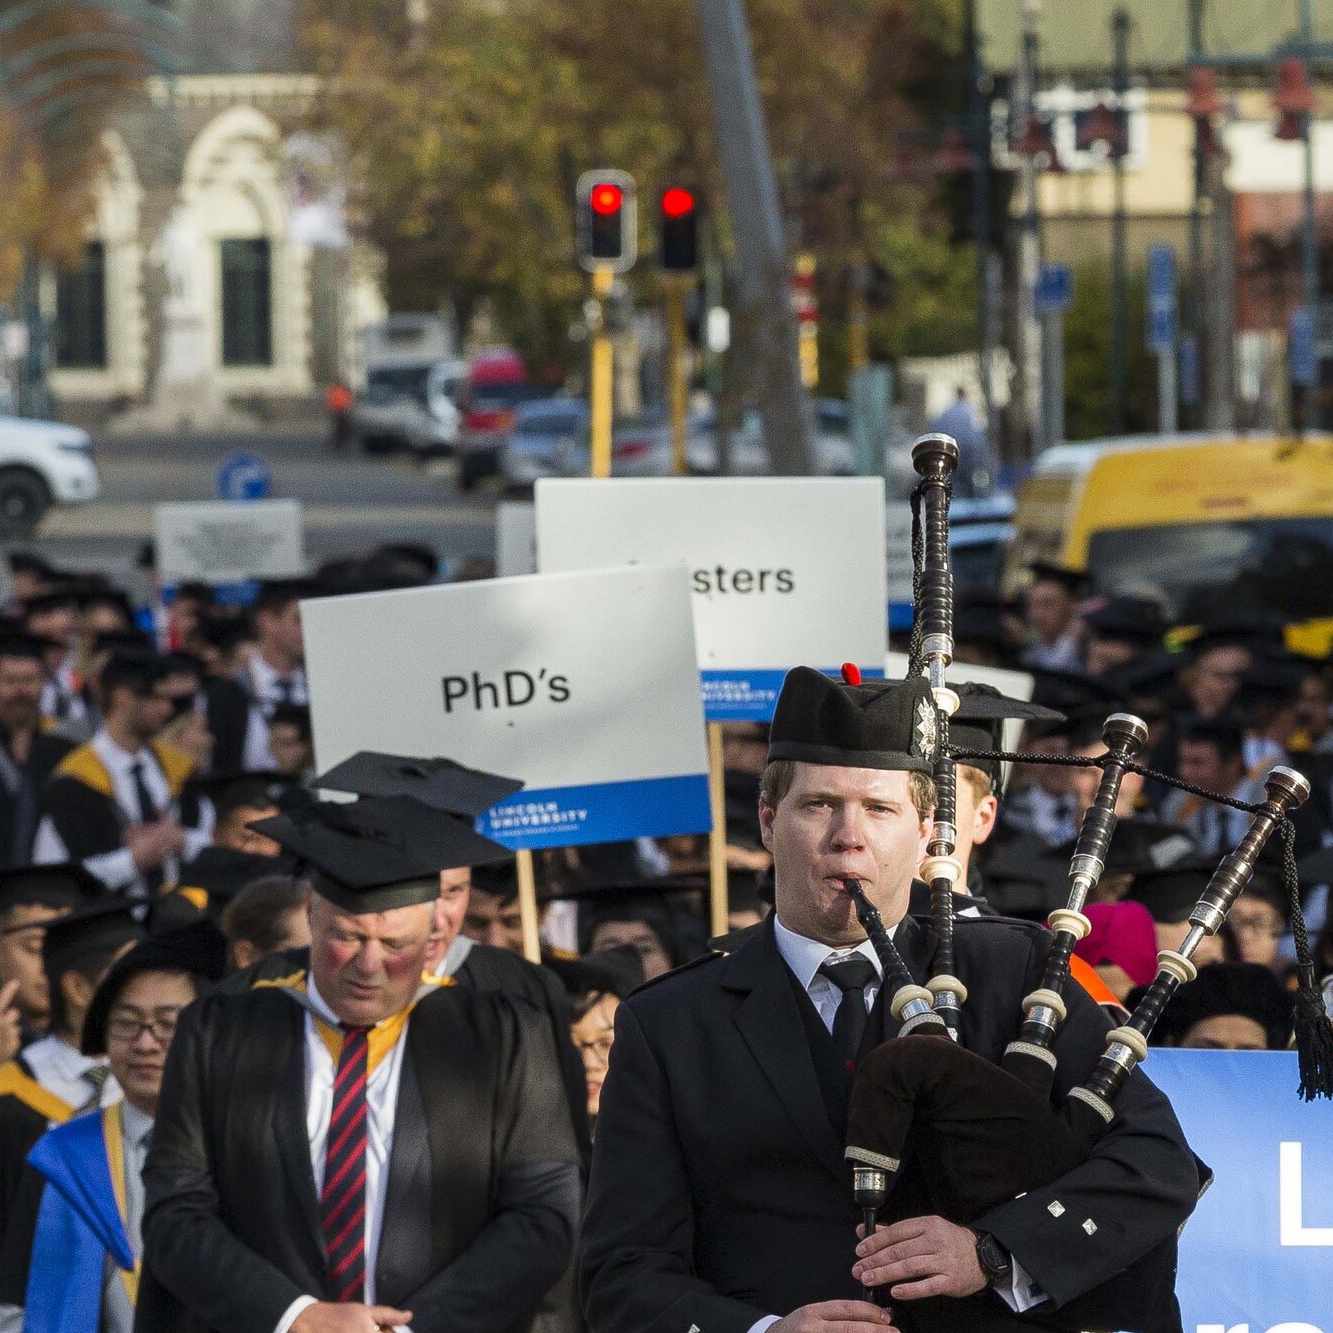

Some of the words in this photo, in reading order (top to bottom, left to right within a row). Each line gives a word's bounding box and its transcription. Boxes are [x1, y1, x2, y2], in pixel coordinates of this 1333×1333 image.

[692, 564, 795, 594] sters
[441, 667, 572, 713] PhD's
[488, 800, 559, 819] LINCOLN
[489, 808, 589, 830] UNIVERSITY
